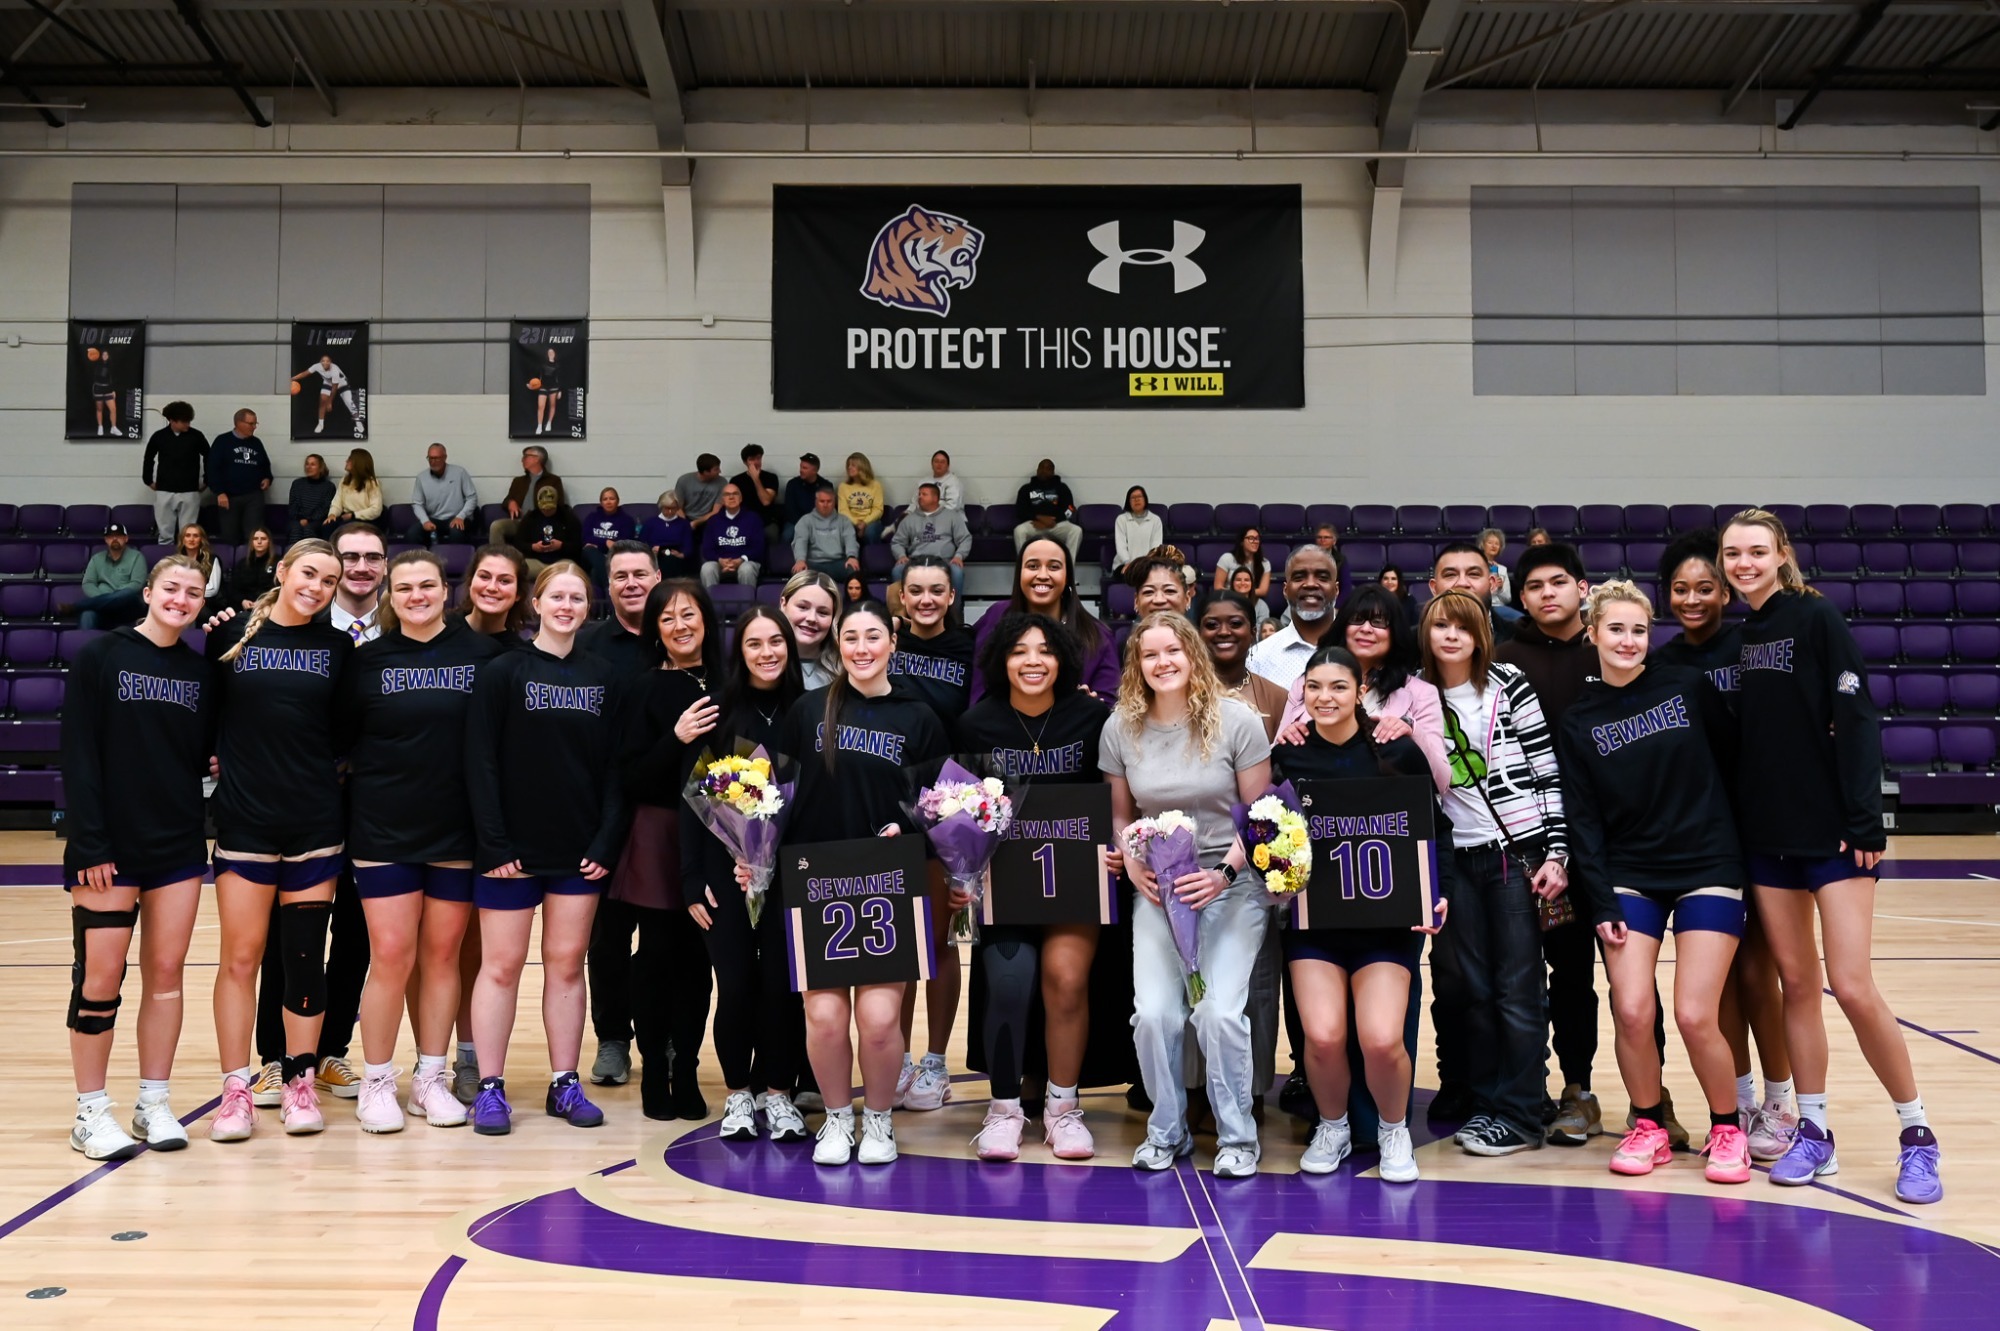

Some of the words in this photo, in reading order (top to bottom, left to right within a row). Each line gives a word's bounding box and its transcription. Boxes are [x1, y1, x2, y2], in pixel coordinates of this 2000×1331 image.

[108, 336, 132, 344] GAMEZ
[326, 337, 352, 345] WRIGHT
[519, 327, 541, 344] 23
[549, 336, 574, 344] FALVEY
[847, 327, 1007, 369] PROTECT
[1017, 327, 1092, 369] THIS
[1163, 377, 1169, 391] I
[1174, 377, 1223, 391] WILL.
[134, 388, 142, 419] SEWANEE
[576, 387, 584, 418] SEWANEE
[234, 646, 330, 678] SEWANEE
[1740, 638, 1794, 673] EWANEE
[118, 670, 200, 712] SEWANEE
[382, 664, 475, 694] SEWANEE
[526, 681, 604, 716] SEWANEE
[1591, 694, 1690, 756] SEWANEE
[815, 722, 905, 766] SWANEE
[992, 741, 1083, 776] SEWANEE
[1310, 811, 1409, 840] SEWANEE
[807, 869, 905, 902] SEWANEE
[1033, 843, 1056, 898] 1
[1330, 839, 1394, 899] 10
[822, 897, 896, 961] 23
